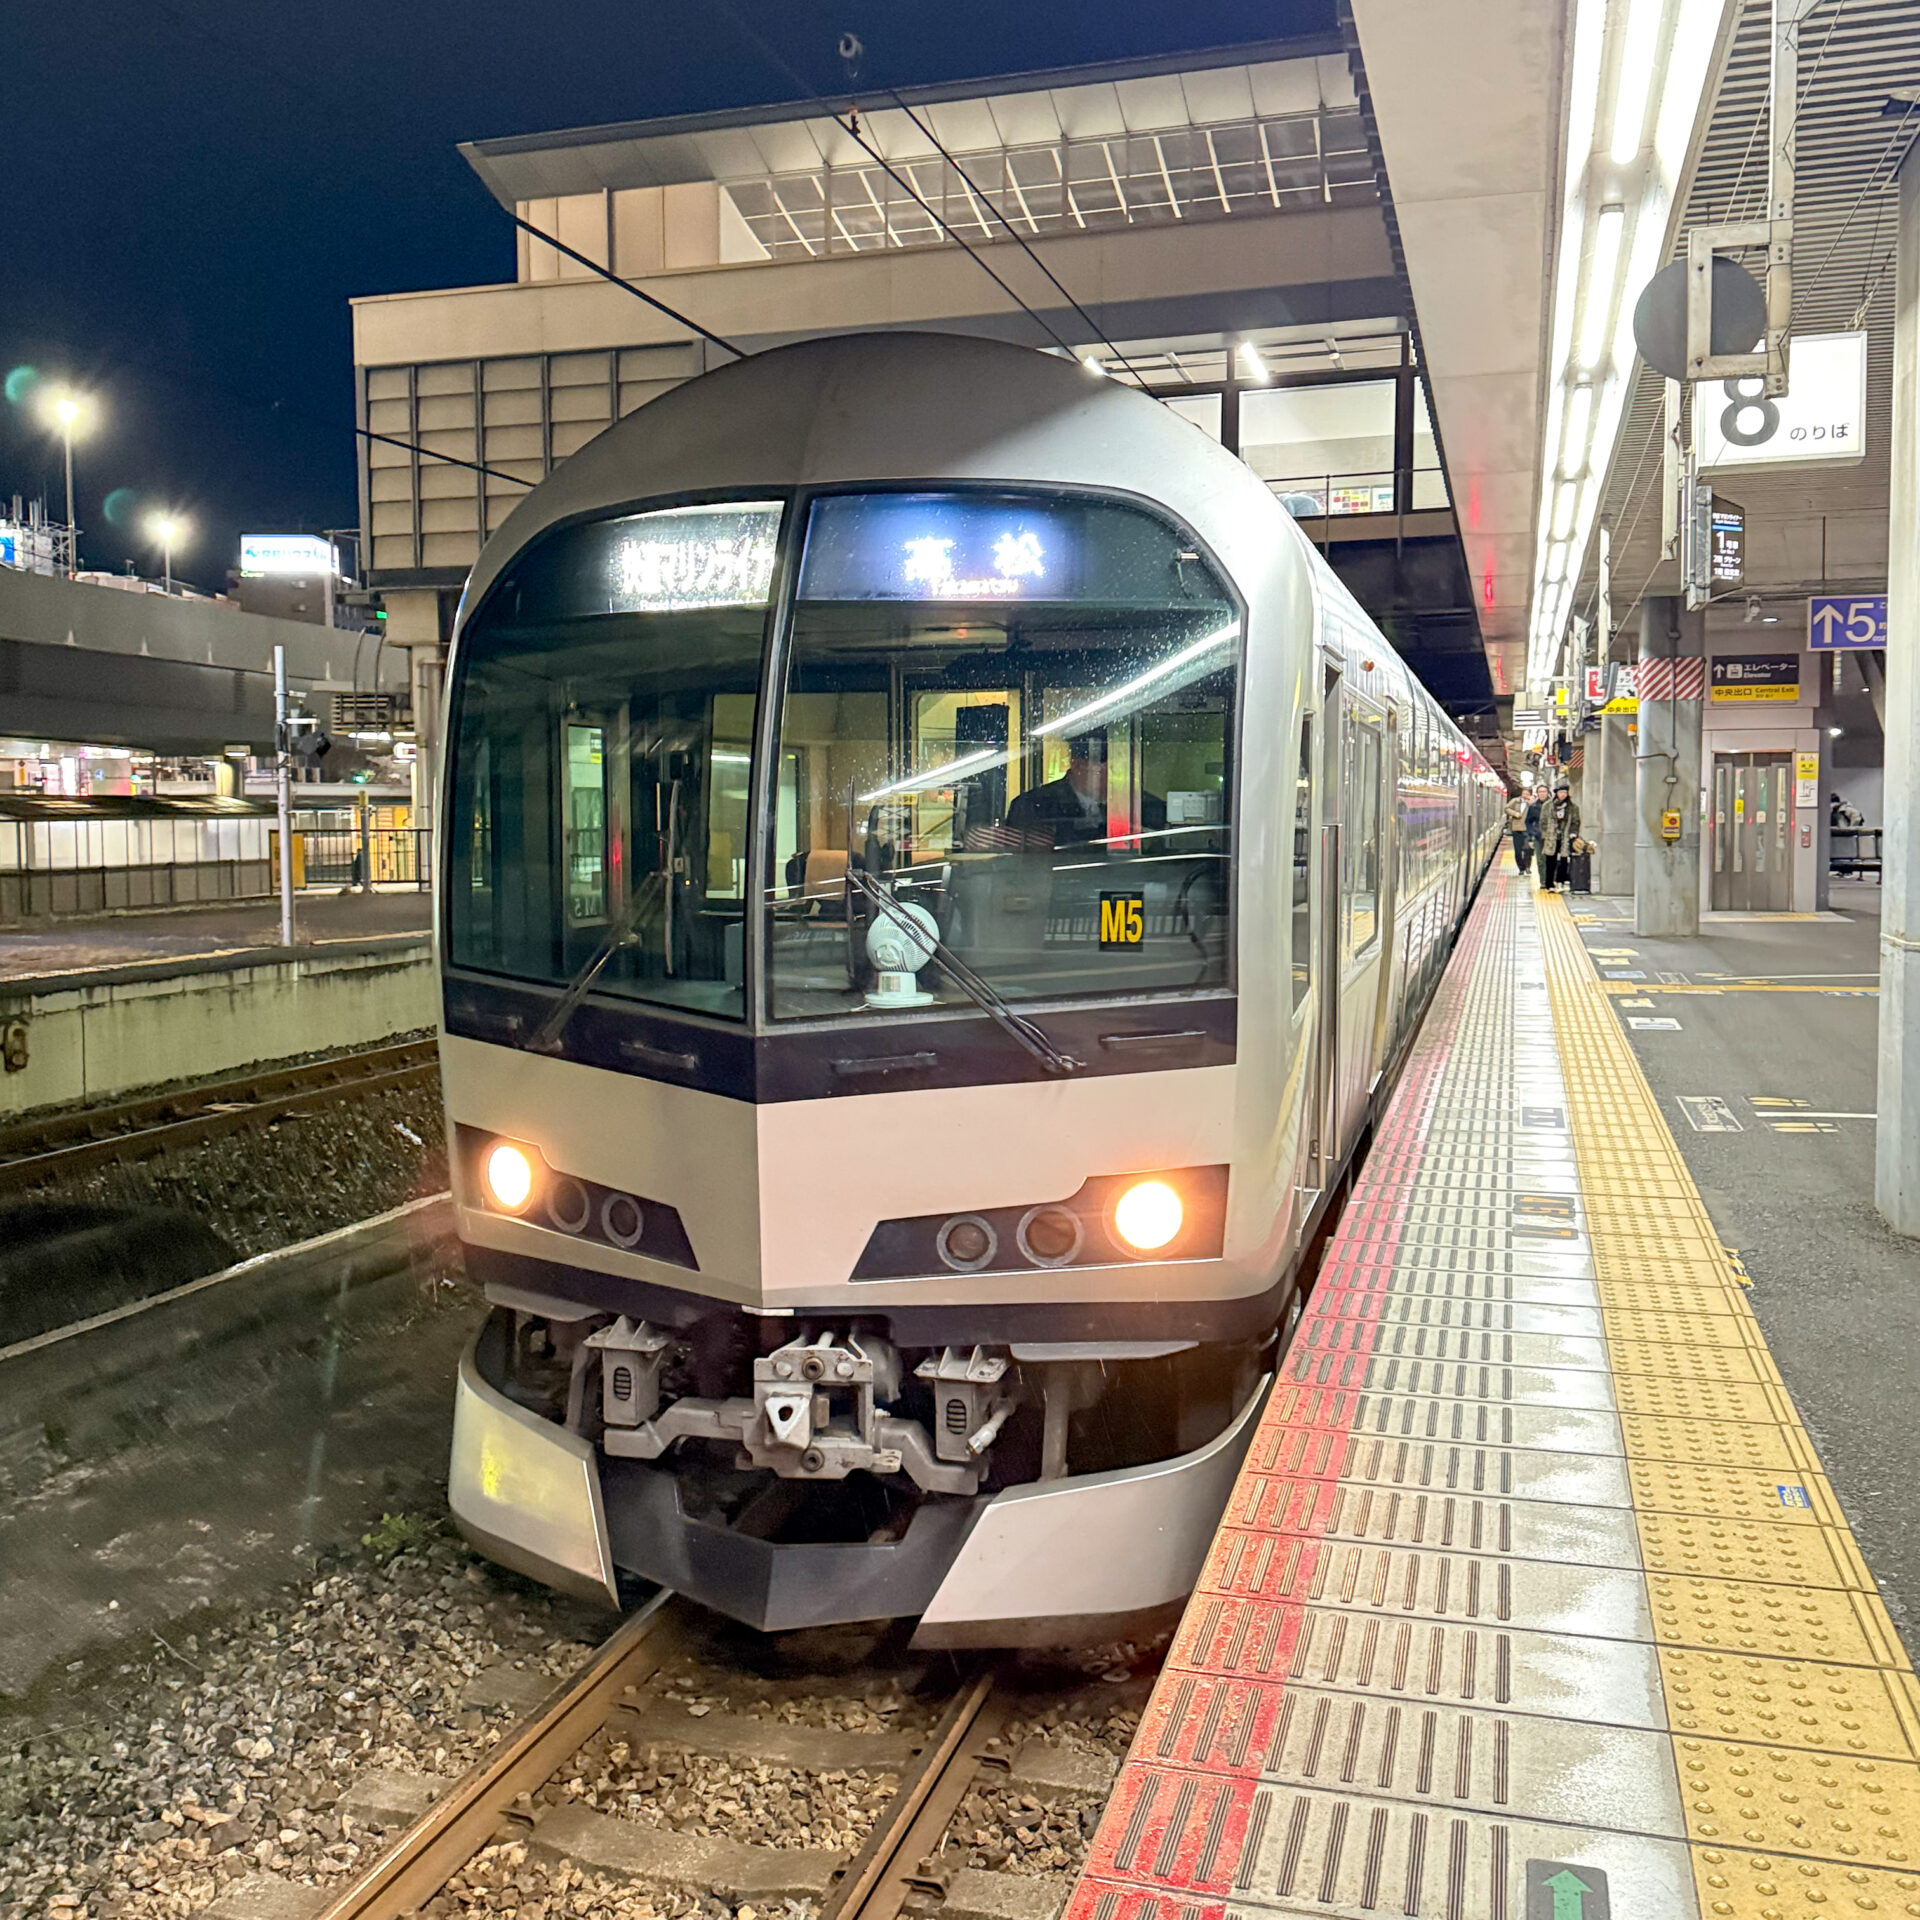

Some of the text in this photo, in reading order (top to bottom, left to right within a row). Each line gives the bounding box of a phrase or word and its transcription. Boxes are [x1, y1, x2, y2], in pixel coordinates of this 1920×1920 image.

[1720, 378, 1850, 446] 8 のりば
[1845, 602, 1876, 642] 5
[1743, 663, 1797, 671] エレベーター
[1714, 688, 1752, 697] 中央出口
[1101, 900, 1142, 943] M5
